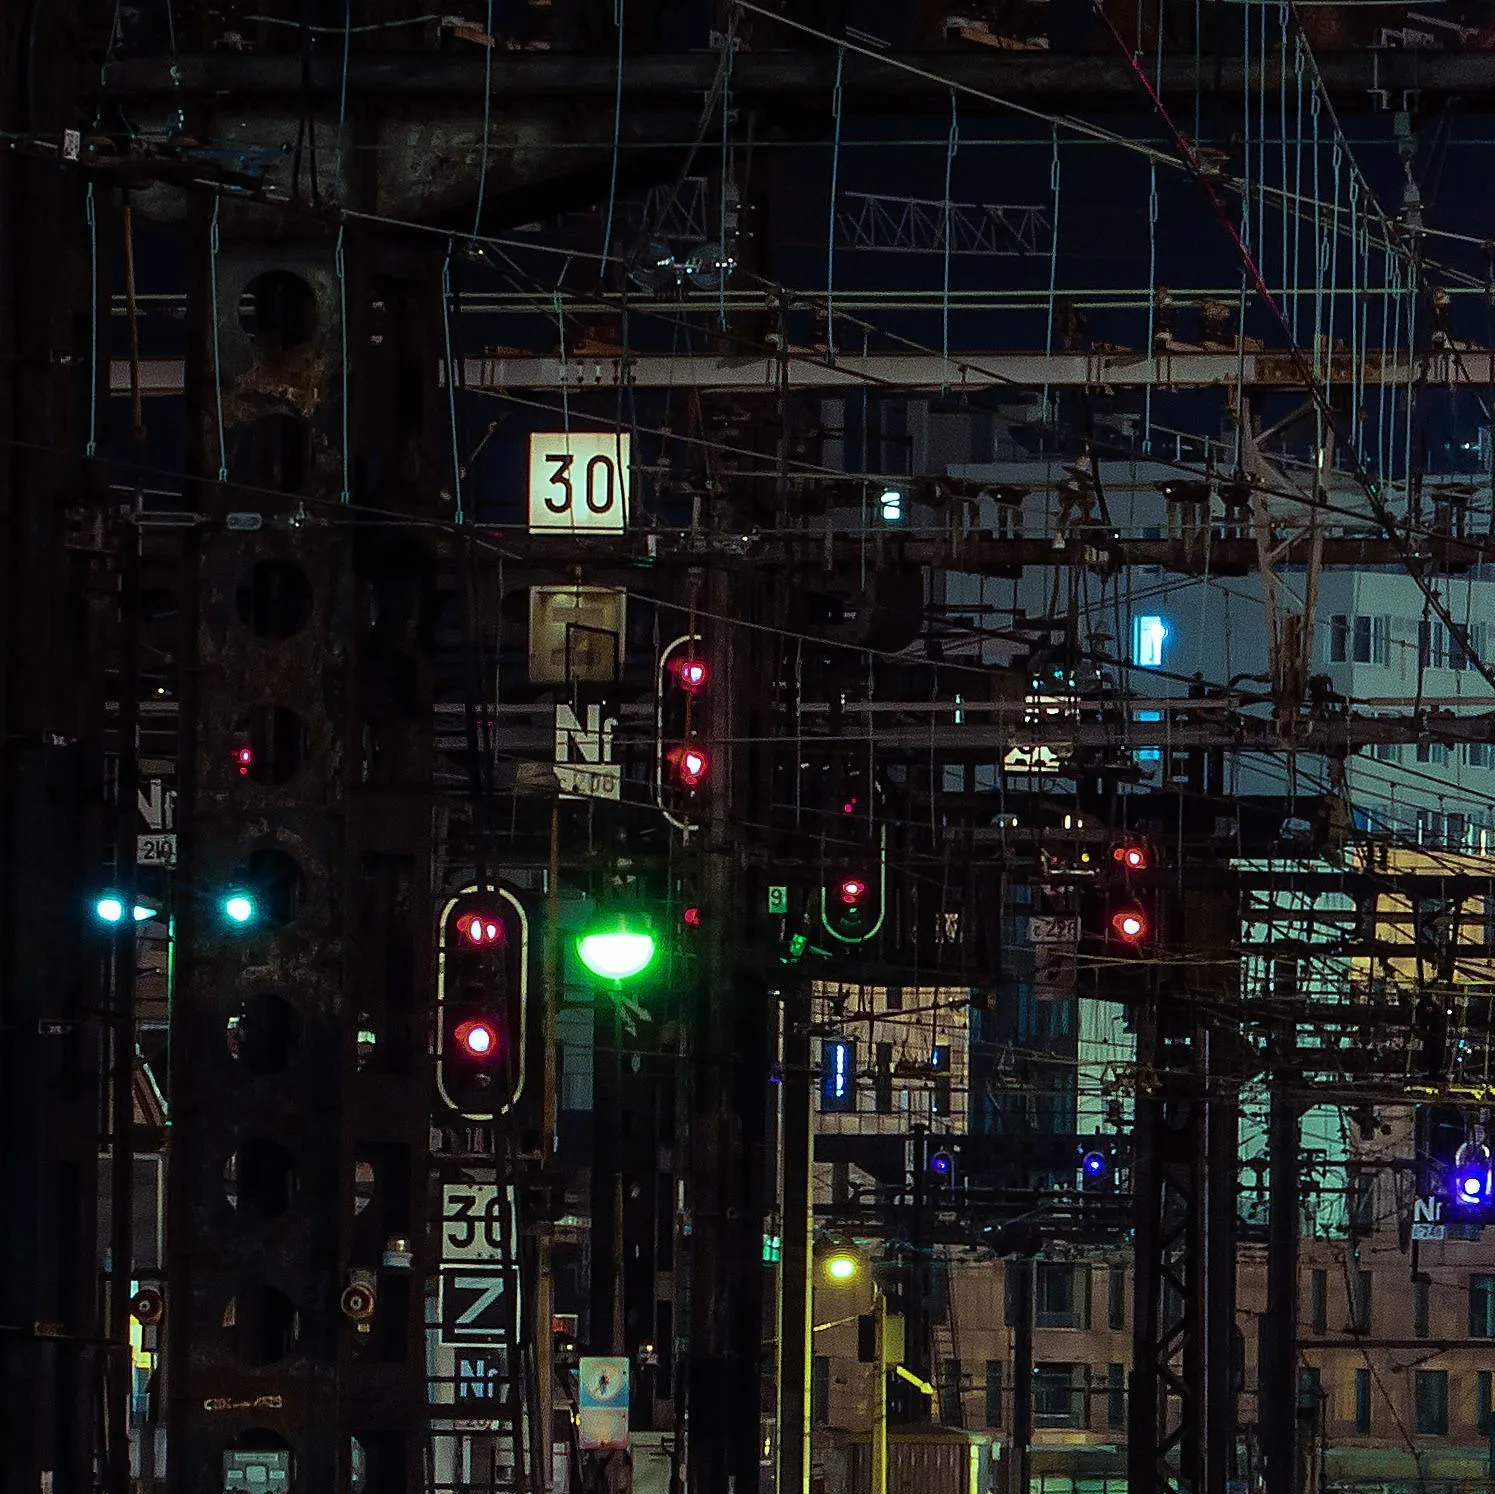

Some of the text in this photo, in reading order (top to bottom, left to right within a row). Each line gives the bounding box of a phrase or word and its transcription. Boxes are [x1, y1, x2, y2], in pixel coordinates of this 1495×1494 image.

[544, 454, 614, 514] 30
[555, 703, 619, 762] Nf
[454, 1276, 506, 1335] Z
